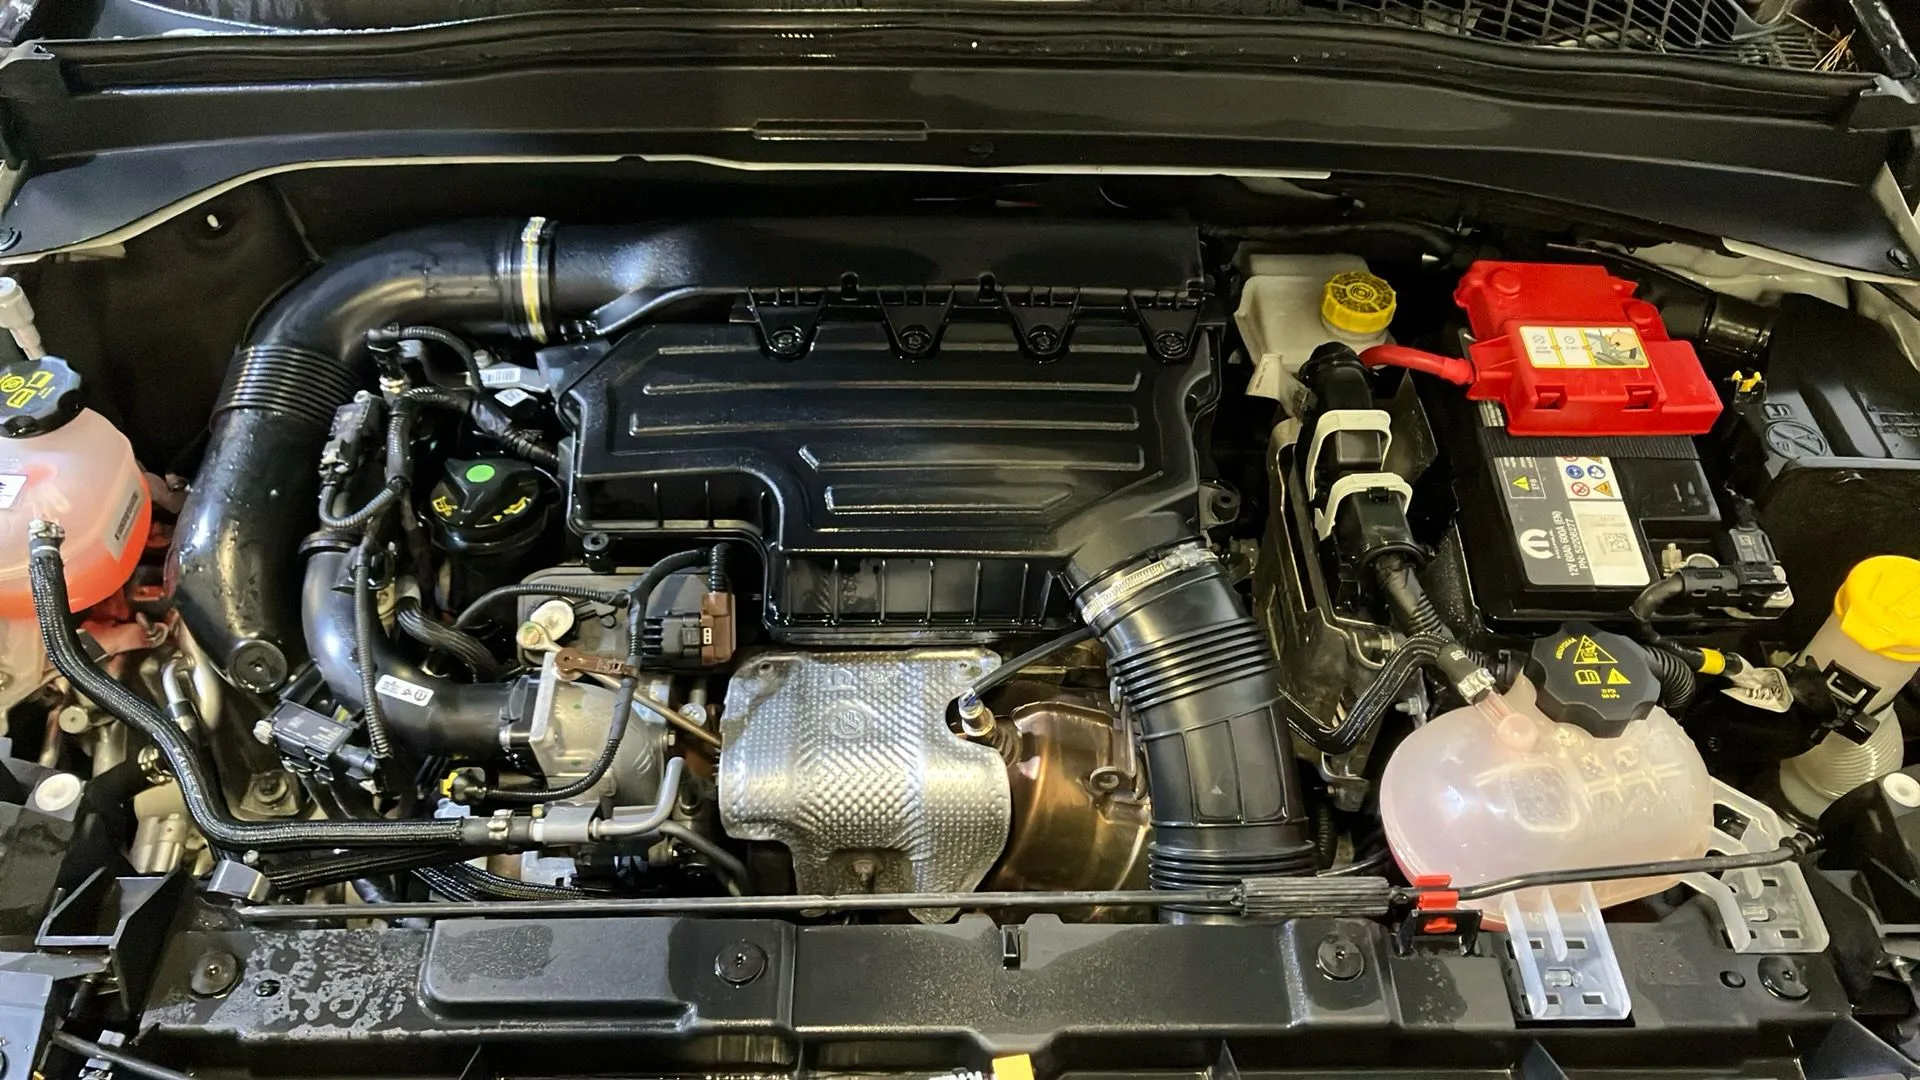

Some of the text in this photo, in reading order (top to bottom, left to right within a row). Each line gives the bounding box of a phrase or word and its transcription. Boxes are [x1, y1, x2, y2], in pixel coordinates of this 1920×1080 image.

[1556, 525, 1569, 544] 600A
[1561, 544, 1575, 563] 60Ah
[1567, 562, 1580, 576] 12V
